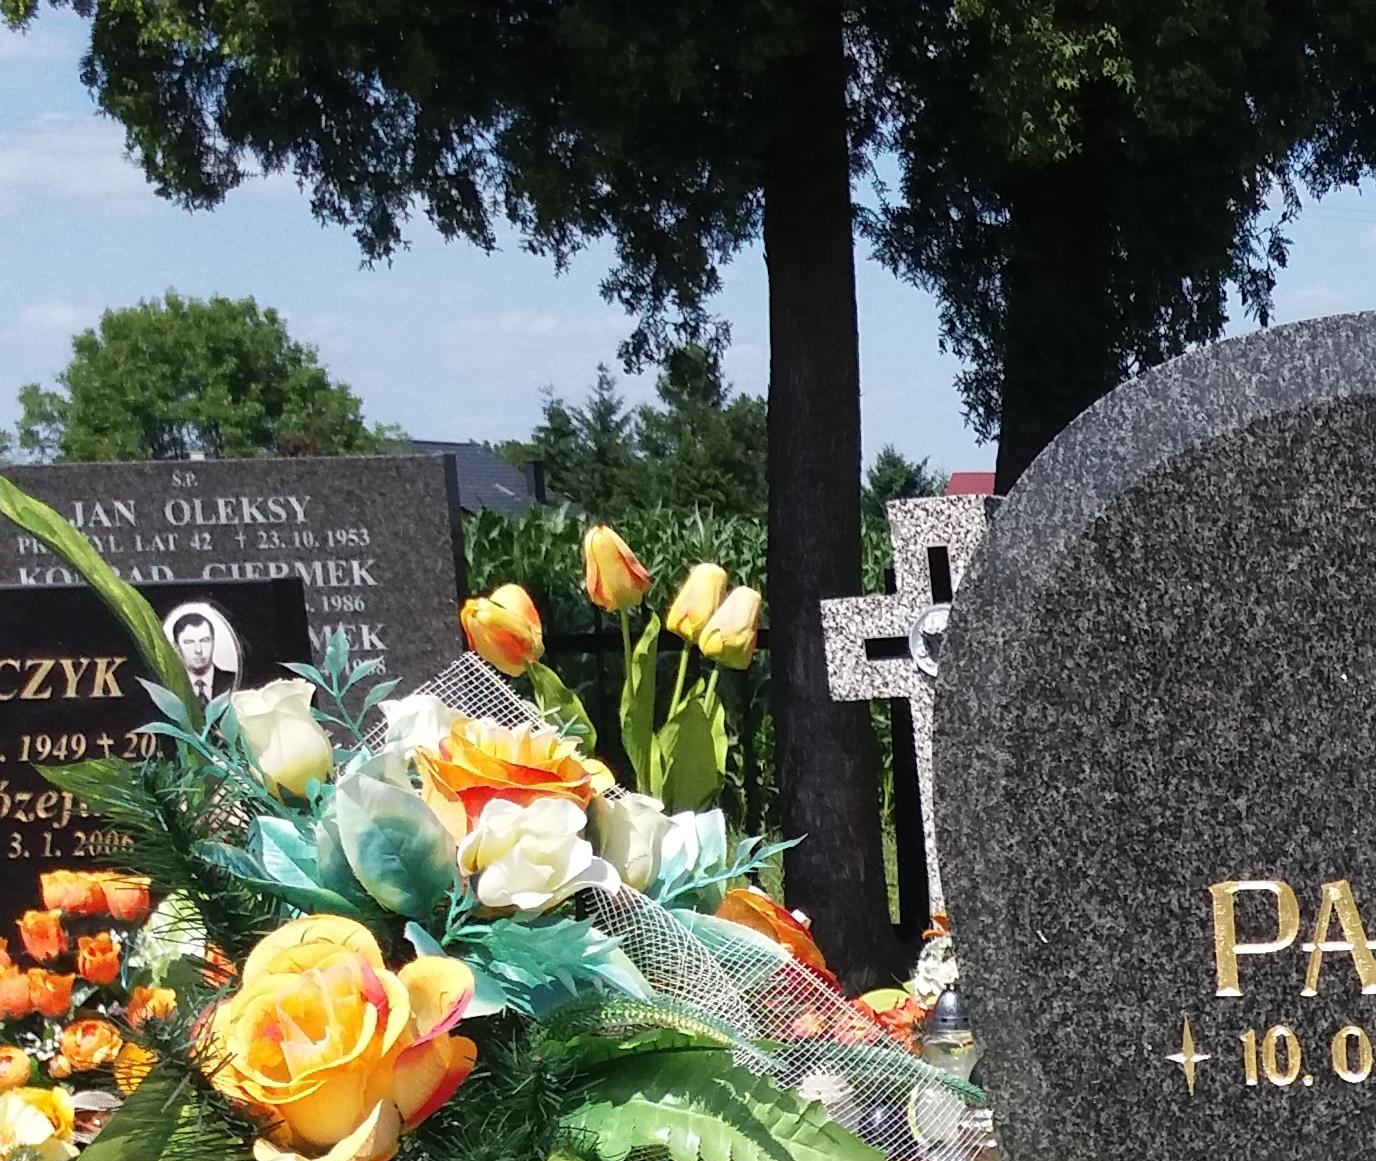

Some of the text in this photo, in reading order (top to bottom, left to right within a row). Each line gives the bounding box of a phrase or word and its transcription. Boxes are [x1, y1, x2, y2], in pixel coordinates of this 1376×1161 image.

[69, 495, 312, 528] JAN OLEKSY
[135, 533, 178, 552] LAT
[189, 532, 213, 551] 42
[18, 732, 88, 763] 1949
